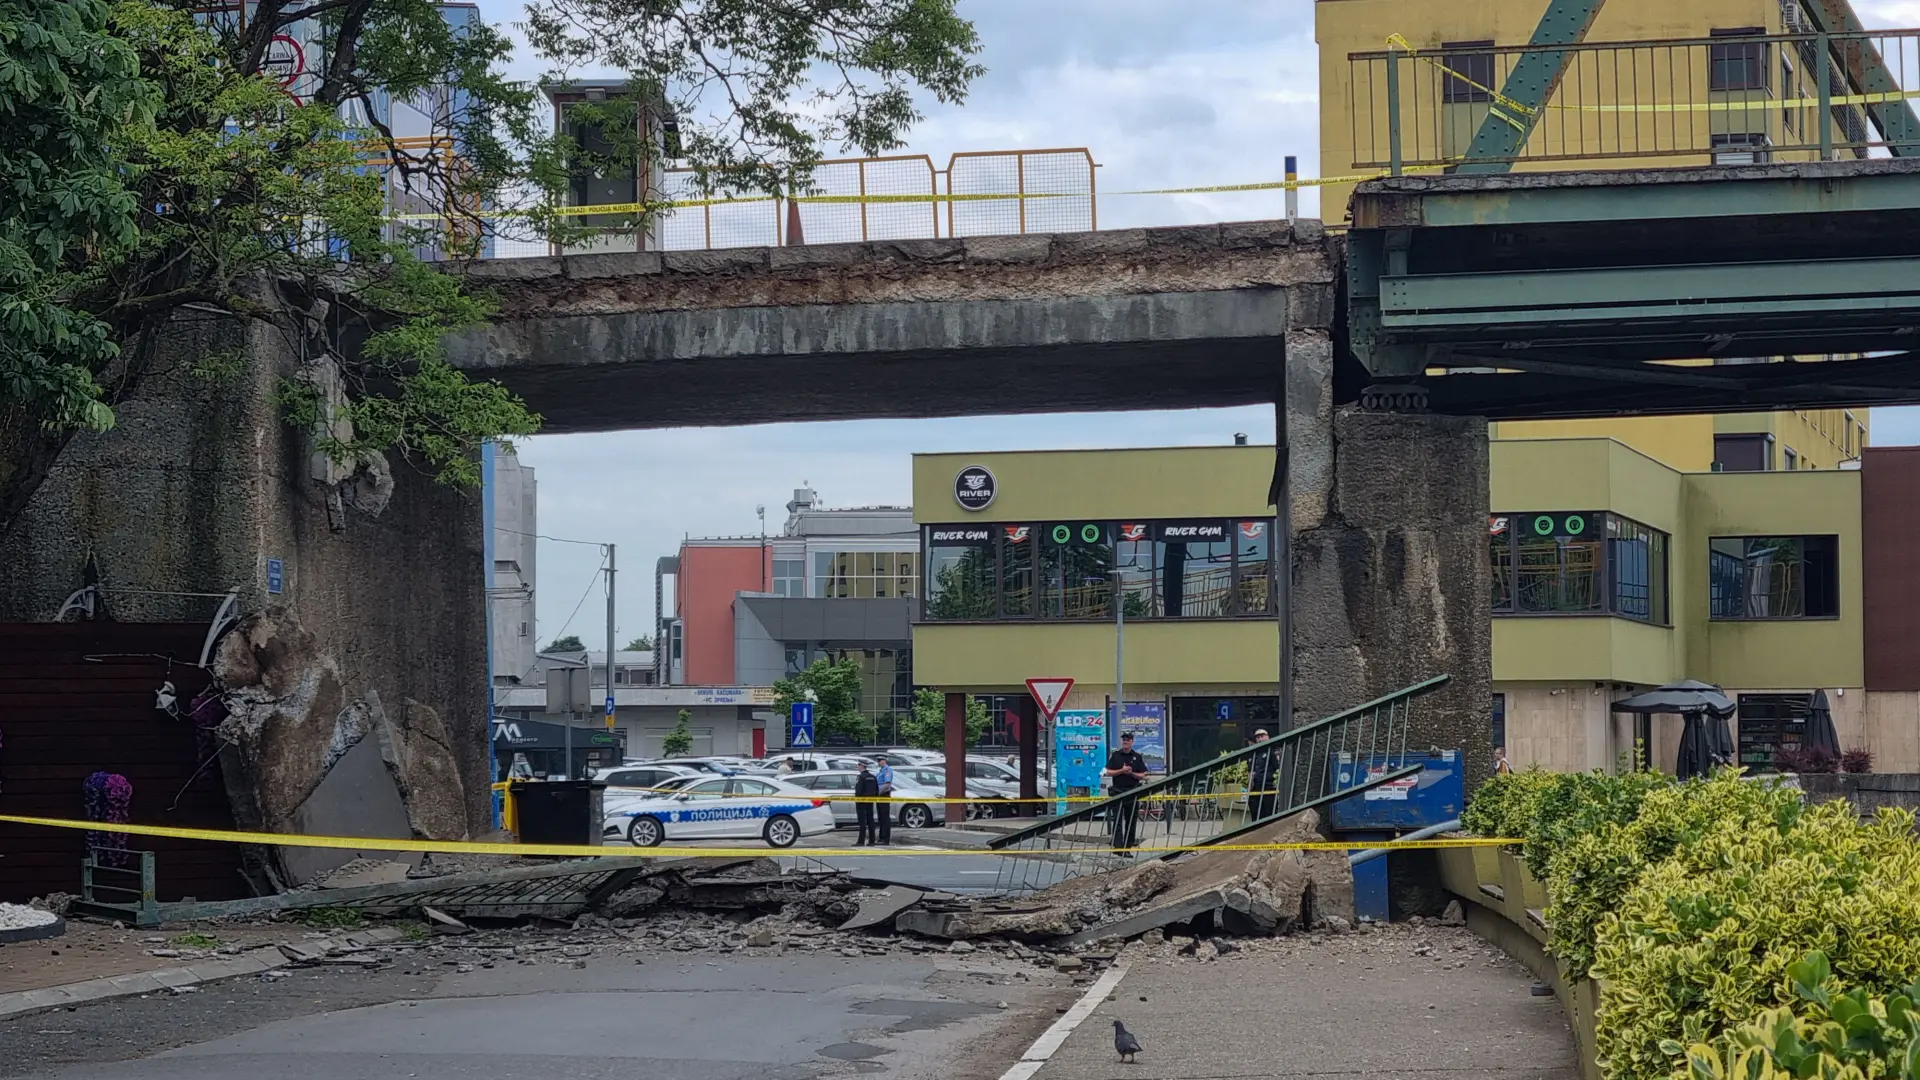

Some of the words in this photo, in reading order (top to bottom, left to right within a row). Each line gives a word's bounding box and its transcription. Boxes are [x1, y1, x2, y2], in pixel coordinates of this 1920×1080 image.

[933, 531, 964, 540] RIVER
[965, 531, 988, 540] GYM
[1165, 526, 1197, 536] RIVER
[1198, 526, 1222, 536] GYM
[606, 700, 612, 714] P
[1056, 714, 1104, 727] LED-24
[690, 808, 753, 821] ПОЛИЦИЈА
